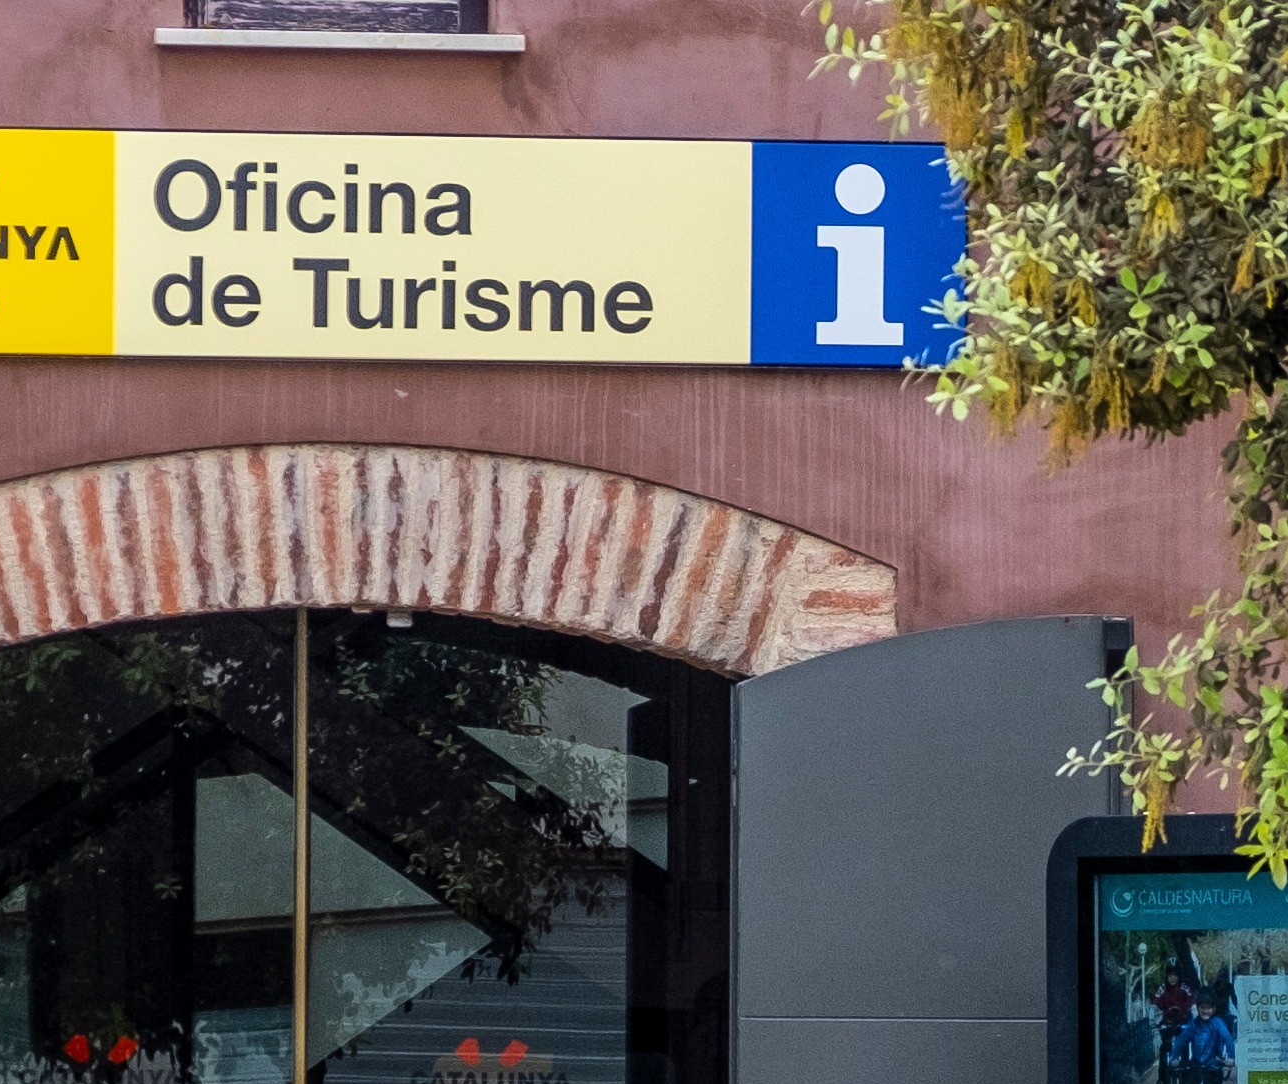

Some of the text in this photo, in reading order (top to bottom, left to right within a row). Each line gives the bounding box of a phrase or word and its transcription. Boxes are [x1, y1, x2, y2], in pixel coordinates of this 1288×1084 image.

[153, 158, 473, 236] Oficina
[816, 163, 904, 346] i
[151, 256, 654, 334] de Turisme
[1138, 888, 1253, 906] CALDESNATURA
